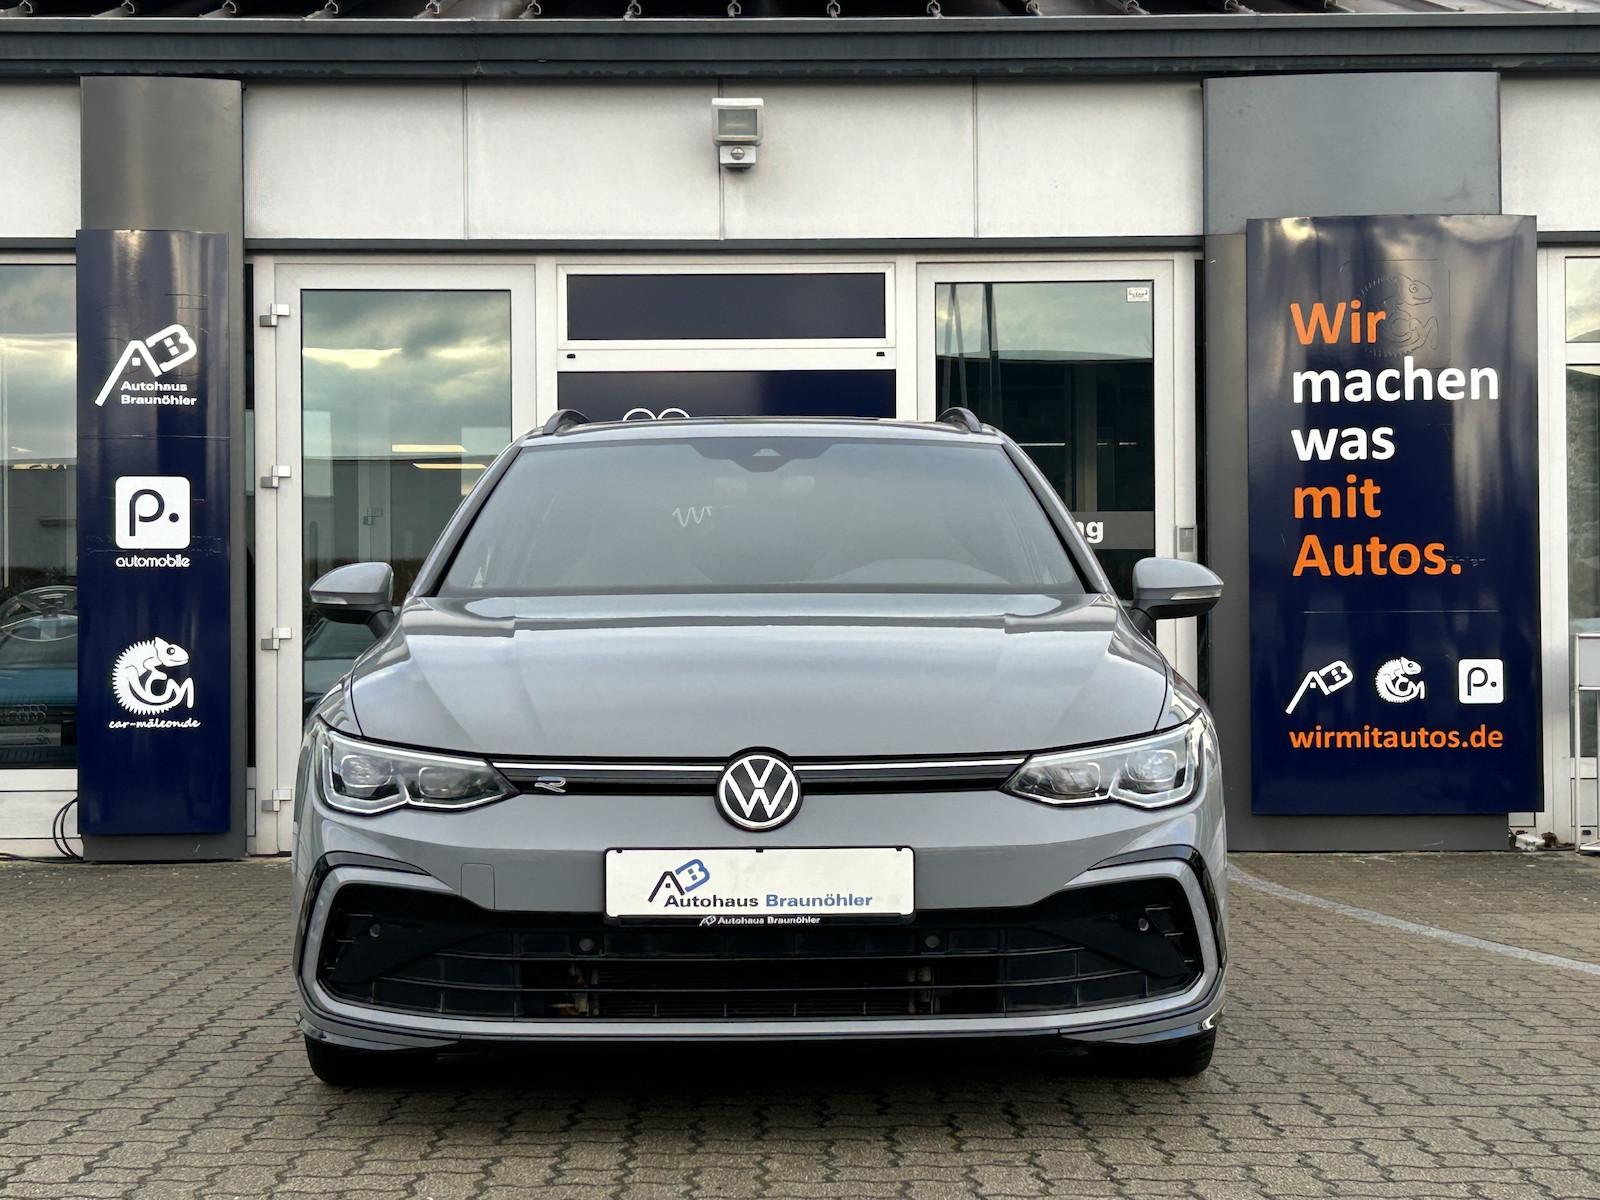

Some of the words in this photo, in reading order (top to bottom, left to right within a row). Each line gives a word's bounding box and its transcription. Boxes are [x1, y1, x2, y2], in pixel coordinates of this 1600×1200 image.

[1290, 299, 1387, 345] Wir
[120, 381, 188, 391] Autohaus
[1293, 355, 1499, 404] machen
[121, 395, 197, 405] Braunöhler
[1290, 426, 1395, 461] was
[1293, 473, 1381, 519] mit
[115, 553, 190, 567] automobile
[1292, 533, 1462, 577] Autos.
[1289, 724, 1504, 749] wirmitautos.de
[664, 894, 759, 907] Autohaus
[765, 893, 873, 907] Braunöhler
[717, 916, 764, 925] Autohaus
[767, 915, 820, 925] Braunöhler
